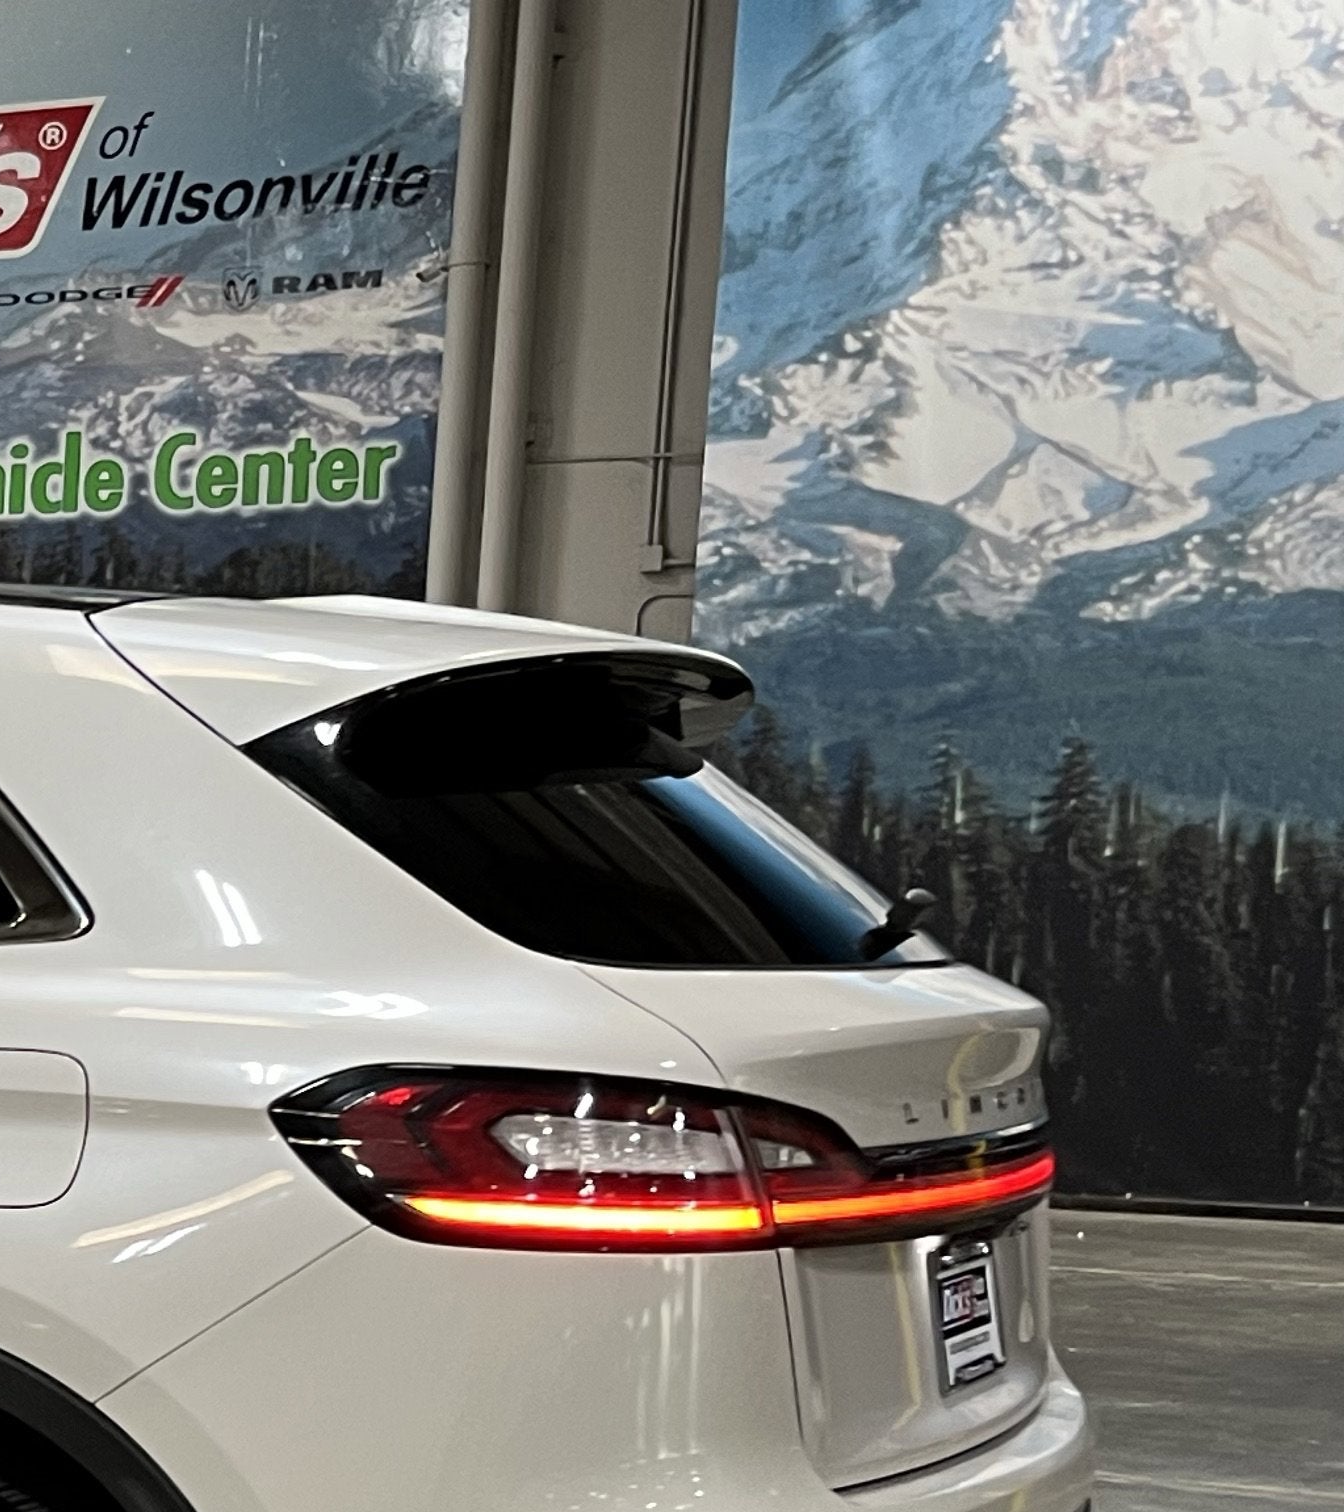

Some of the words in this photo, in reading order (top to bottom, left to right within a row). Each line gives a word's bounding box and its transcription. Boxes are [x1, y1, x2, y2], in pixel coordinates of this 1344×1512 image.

[99, 111, 155, 160] of
[81, 151, 430, 231] Wilsonville
[271, 269, 384, 295] RAM
[154, 431, 397, 509] Center
